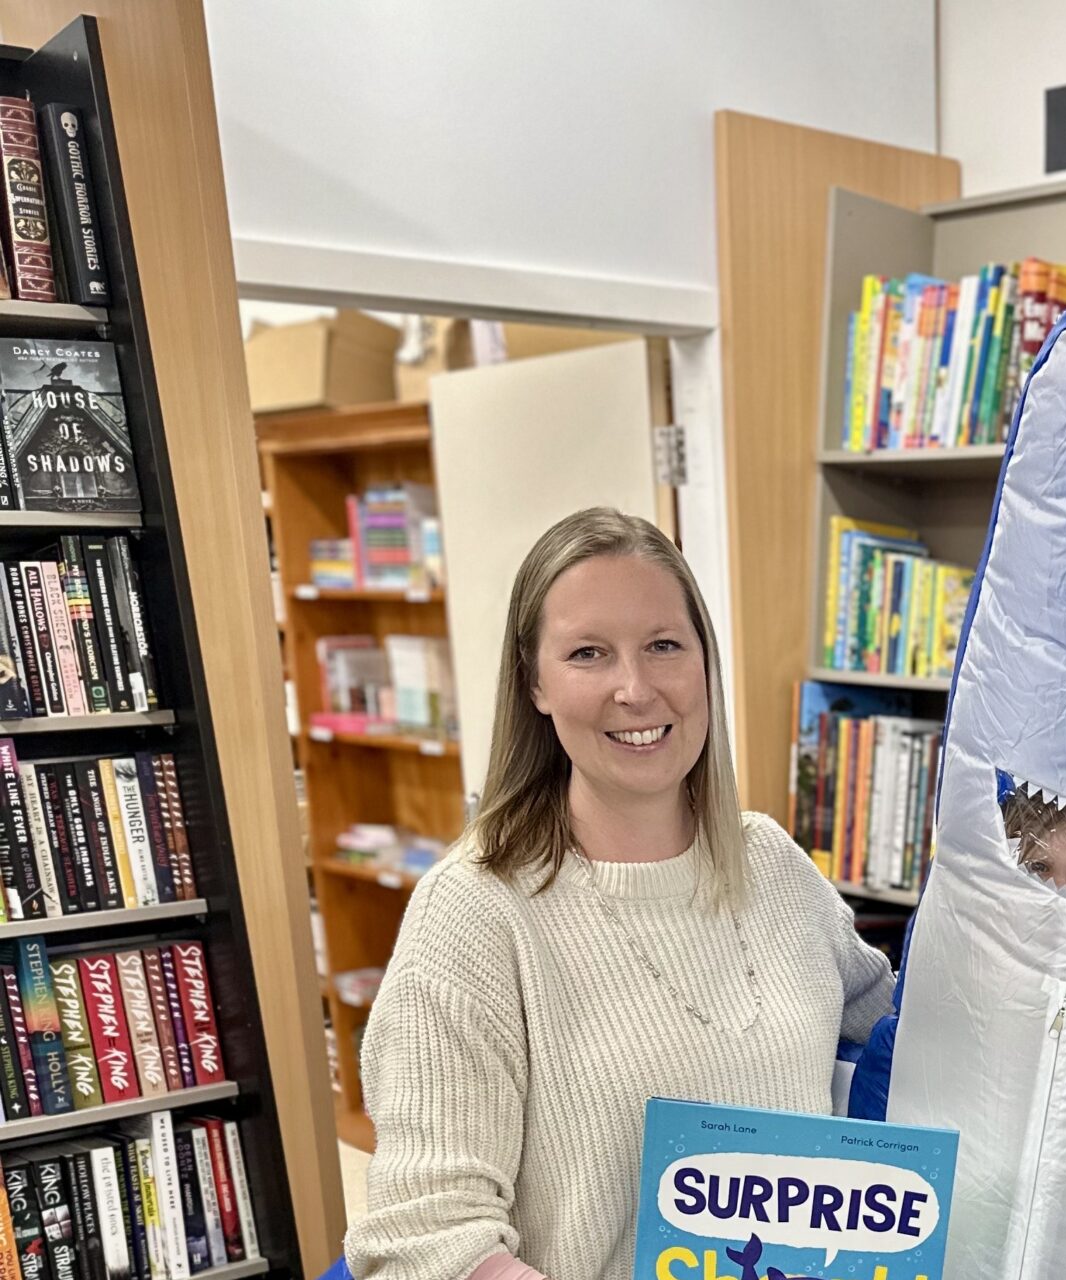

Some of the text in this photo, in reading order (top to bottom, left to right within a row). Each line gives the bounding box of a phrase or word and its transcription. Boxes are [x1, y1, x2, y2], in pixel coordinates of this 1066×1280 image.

[67, 140, 100, 271] GOTHIC HORROR STORIES
[31, 391, 100, 410] HOUSE
[59, 422, 83, 442] OF
[26, 454, 126, 473] SHADOWS
[25, 569, 47, 632] ALL HALLOWS
[87, 769, 98, 788] THE
[7, 782, 28, 843] LINE FEVER
[91, 790, 103, 819] ANGEL
[123, 793, 146, 845] HUNGER
[68, 790, 94, 887] ONLY GOOD INDIANS
[100, 835, 113, 868] INDIAN
[106, 869, 118, 894] LAKE
[26, 943, 66, 1095] STEPHEN HOLLY
[49, 963, 96, 1097] STEPHEN KING
[83, 958, 130, 1091] STEPHEN KING
[116, 954, 163, 1085] STEPHEN KING
[176, 944, 219, 1074] STEPHEN KING
[701, 1120, 757, 1135] Sarah Lane
[840, 1136, 919, 1153] Patrick Corrigan
[5, 1170, 28, 1213] KING
[39, 1163, 61, 1205] KING
[673, 1167, 928, 1237] SURPRISE
[81, 1195, 96, 1236] PLACES
